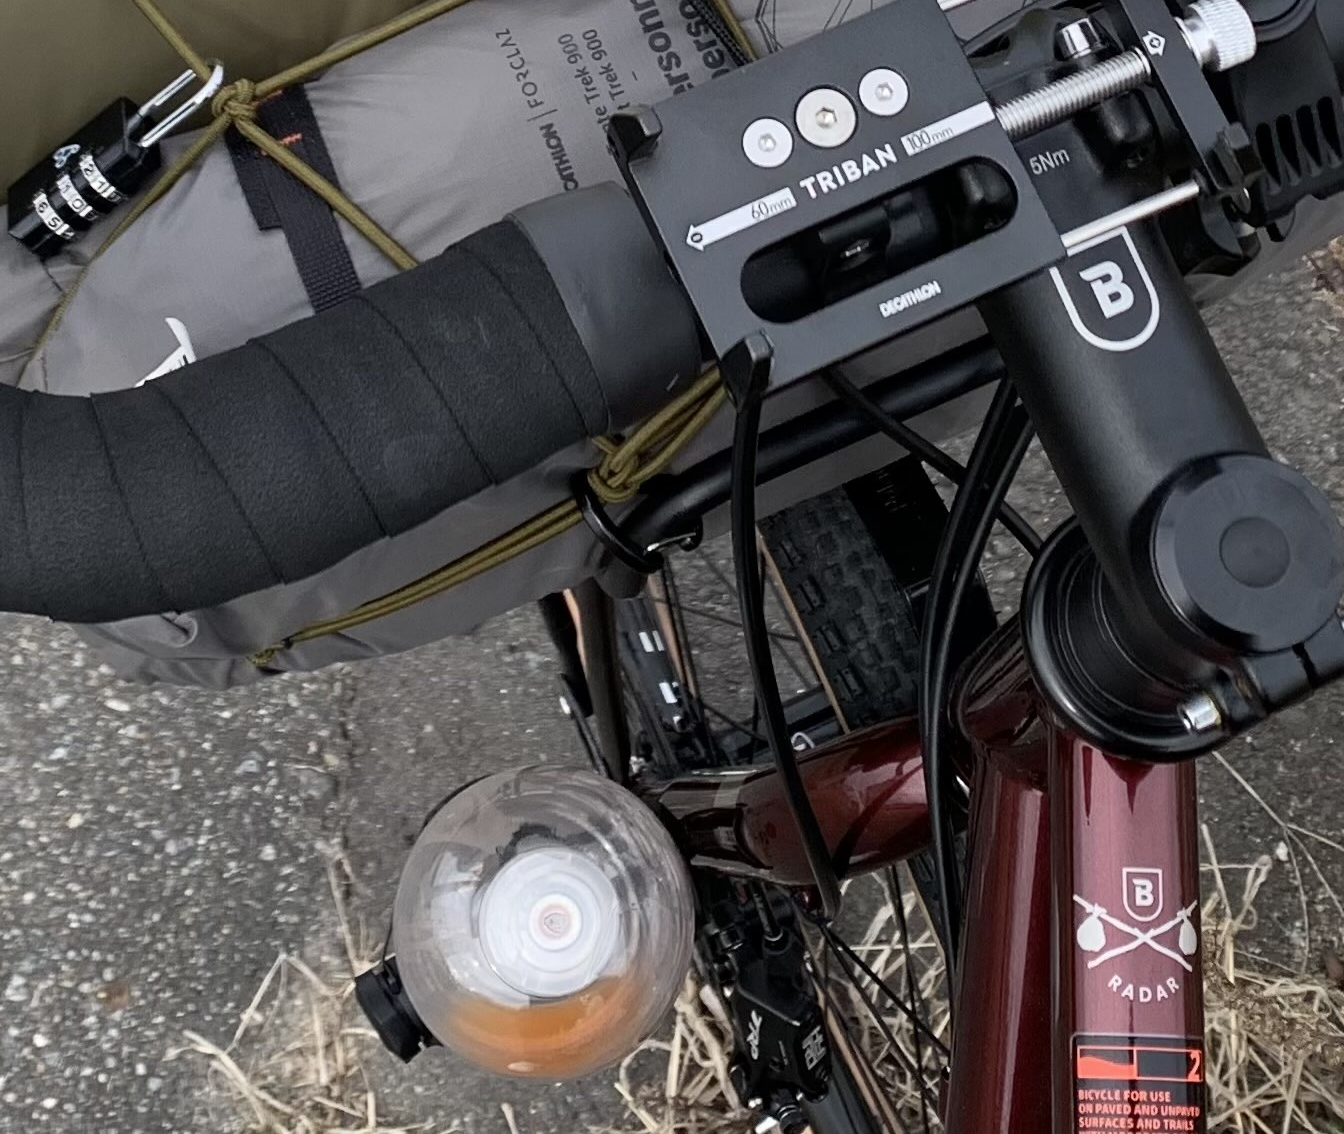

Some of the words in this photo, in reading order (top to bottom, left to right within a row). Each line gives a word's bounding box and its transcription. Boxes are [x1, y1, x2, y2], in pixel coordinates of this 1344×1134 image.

[558, 33, 584, 65] 900
[582, 28, 608, 61] 900
[495, 27, 544, 109] FORCLAZ
[598, 62, 625, 102] Trek
[574, 66, 600, 105] Trek
[799, 143, 897, 199] TRIBAN
[906, 126, 954, 152] 100mm
[878, 280, 942, 318] DECATHLON
[1079, 260, 1134, 319] B
[1132, 878, 1154, 906] B
[1107, 974, 1180, 1003] RADAR
[1188, 1049, 1201, 1082] 2
[1078, 1089, 1121, 1101] BICYCLE
[1123, 1090, 1147, 1102] FOR
[1150, 1091, 1171, 1103] USE
[1078, 1103, 1094, 1114] ON
[1096, 1104, 1131, 1115] PAVED
[1134, 1104, 1158, 1116] AND
[1078, 1117, 1134, 1128] SURFACES
[1136, 1119, 1161, 1130] AND
[1163, 1119, 1195, 1131] TRAILS
